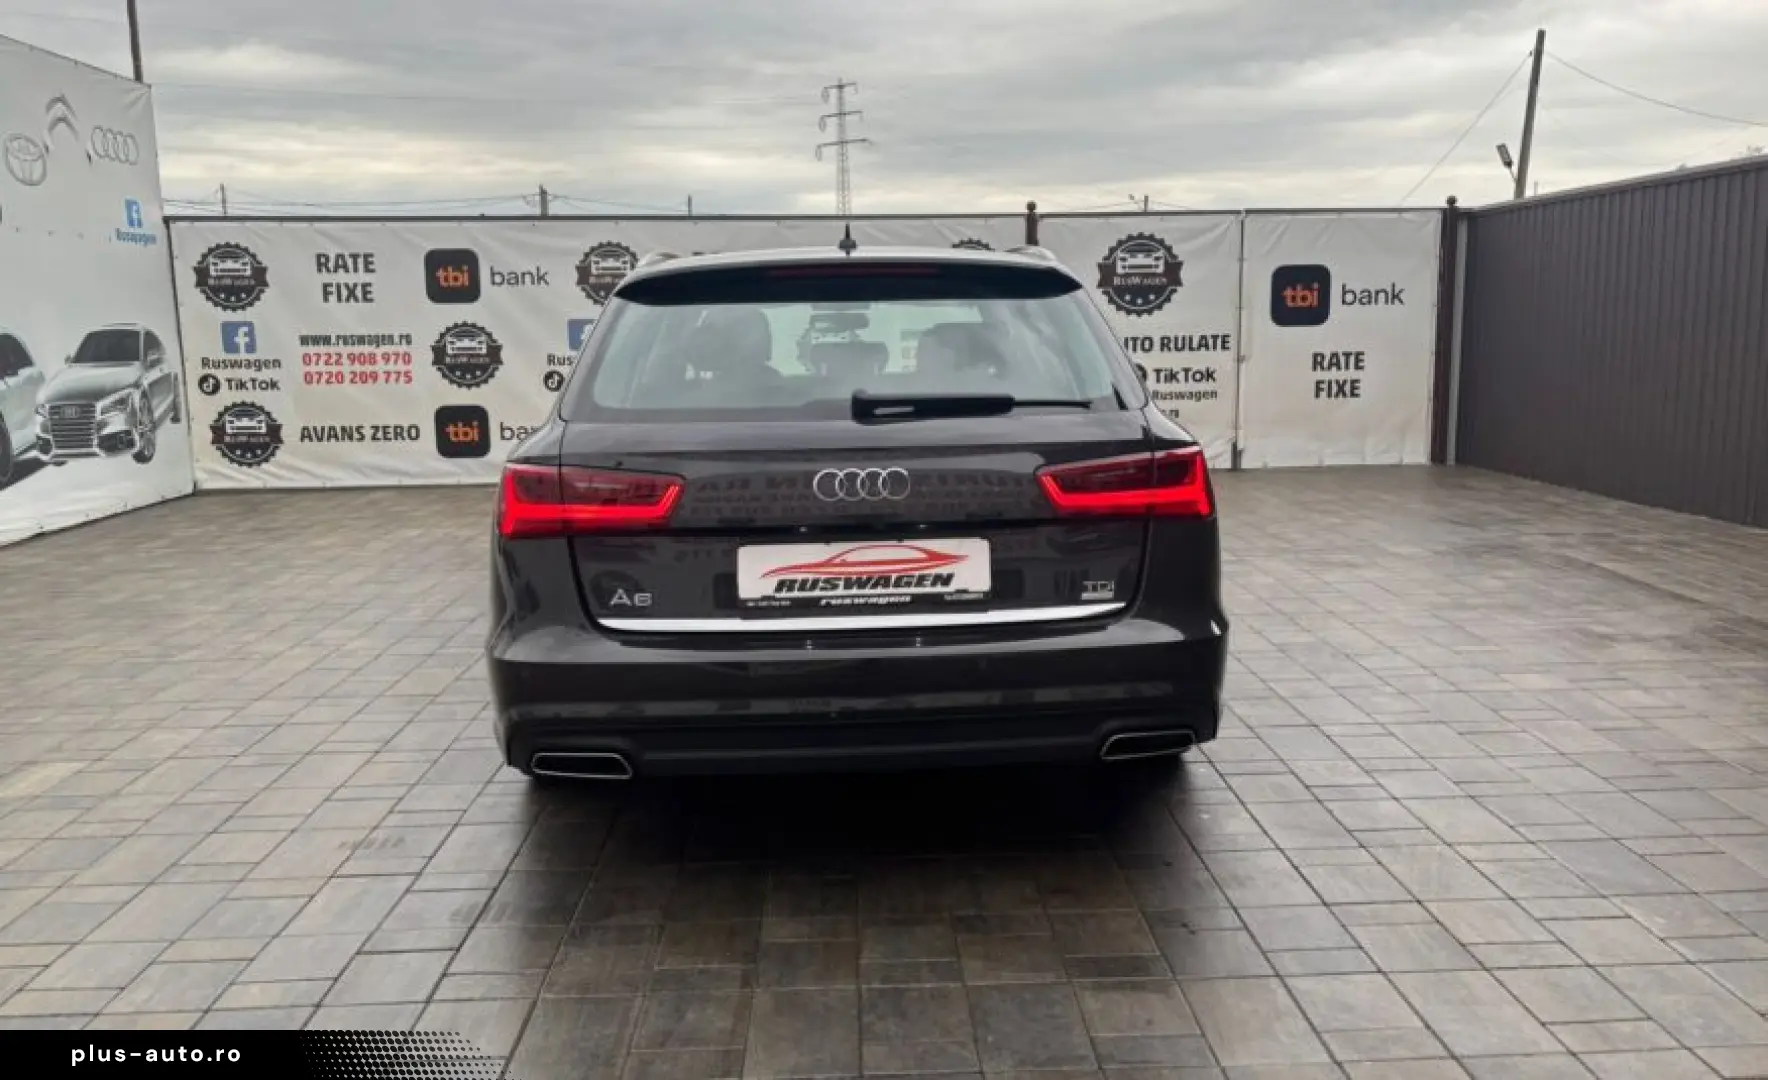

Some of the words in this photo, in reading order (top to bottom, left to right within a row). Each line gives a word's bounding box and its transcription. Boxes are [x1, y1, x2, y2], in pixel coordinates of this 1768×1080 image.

[315, 253, 376, 273] RATE
[435, 264, 470, 288] tbi
[490, 266, 549, 287] bank
[322, 282, 374, 303] FIXE
[1281, 282, 1320, 308] tbi
[1341, 282, 1405, 306] bank
[299, 333, 413, 348] www.ruswagen.ro
[1160, 335, 1231, 351] RULATE
[201, 356, 281, 371] Ruswagen
[302, 352, 343, 366] 0722
[347, 352, 377, 366] 908
[381, 352, 412, 366] 970
[1312, 351, 1365, 372] RATE
[225, 377, 281, 392] TikTok
[304, 371, 344, 385] 0720
[349, 371, 379, 385] 209
[383, 371, 413, 385] 775
[1153, 367, 1217, 384] TikTok
[1151, 390, 1217, 402] Ruswagen
[1314, 379, 1361, 399] FIXE
[299, 424, 365, 443] AVANS
[371, 424, 420, 443] ZERO
[445, 421, 479, 443] tbi
[774, 573, 955, 593] RUSWAGEN
[608, 588, 653, 607] A6
